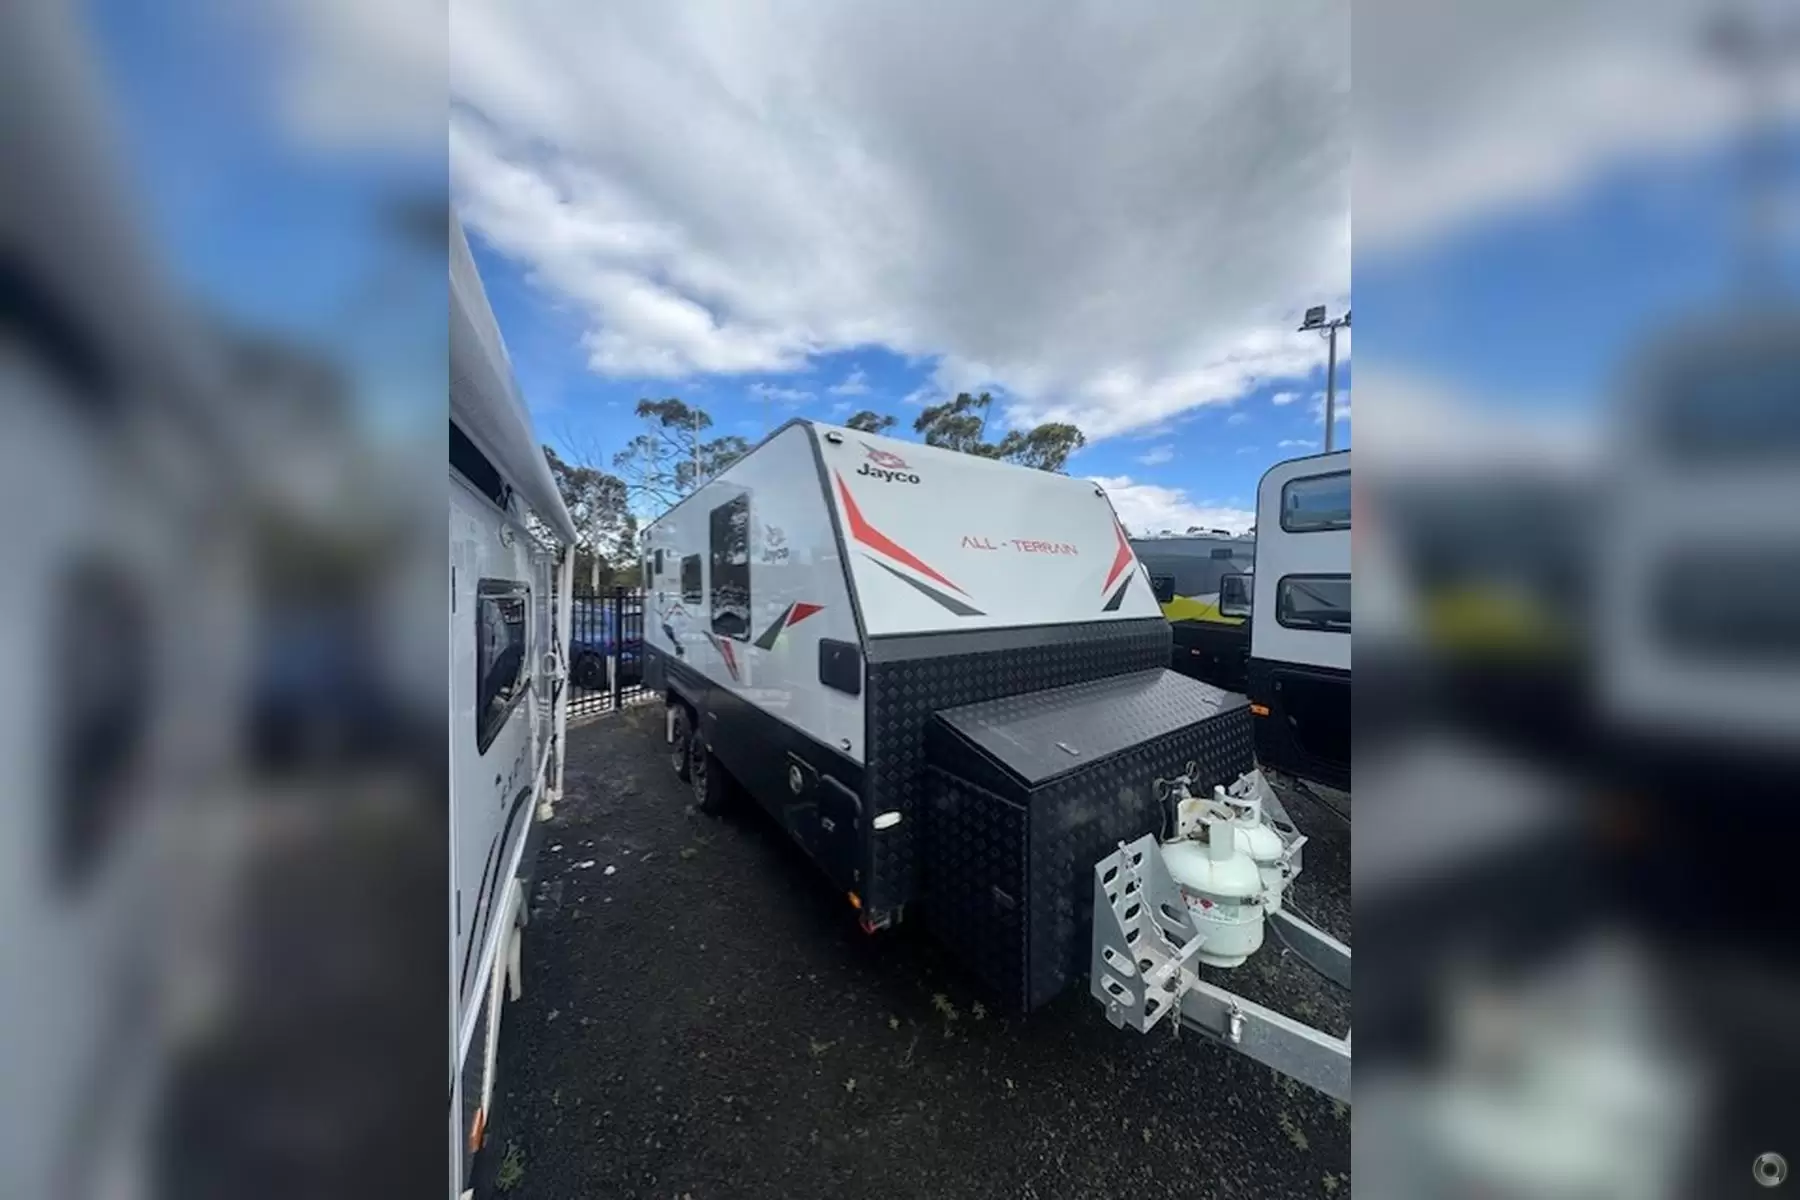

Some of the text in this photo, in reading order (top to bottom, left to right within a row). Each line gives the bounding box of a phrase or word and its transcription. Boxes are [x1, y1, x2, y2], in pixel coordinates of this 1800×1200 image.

[856, 463, 920, 484] Jayco
[961, 536, 998, 550] ALL
[1011, 540, 1079, 555] TERRAIN
